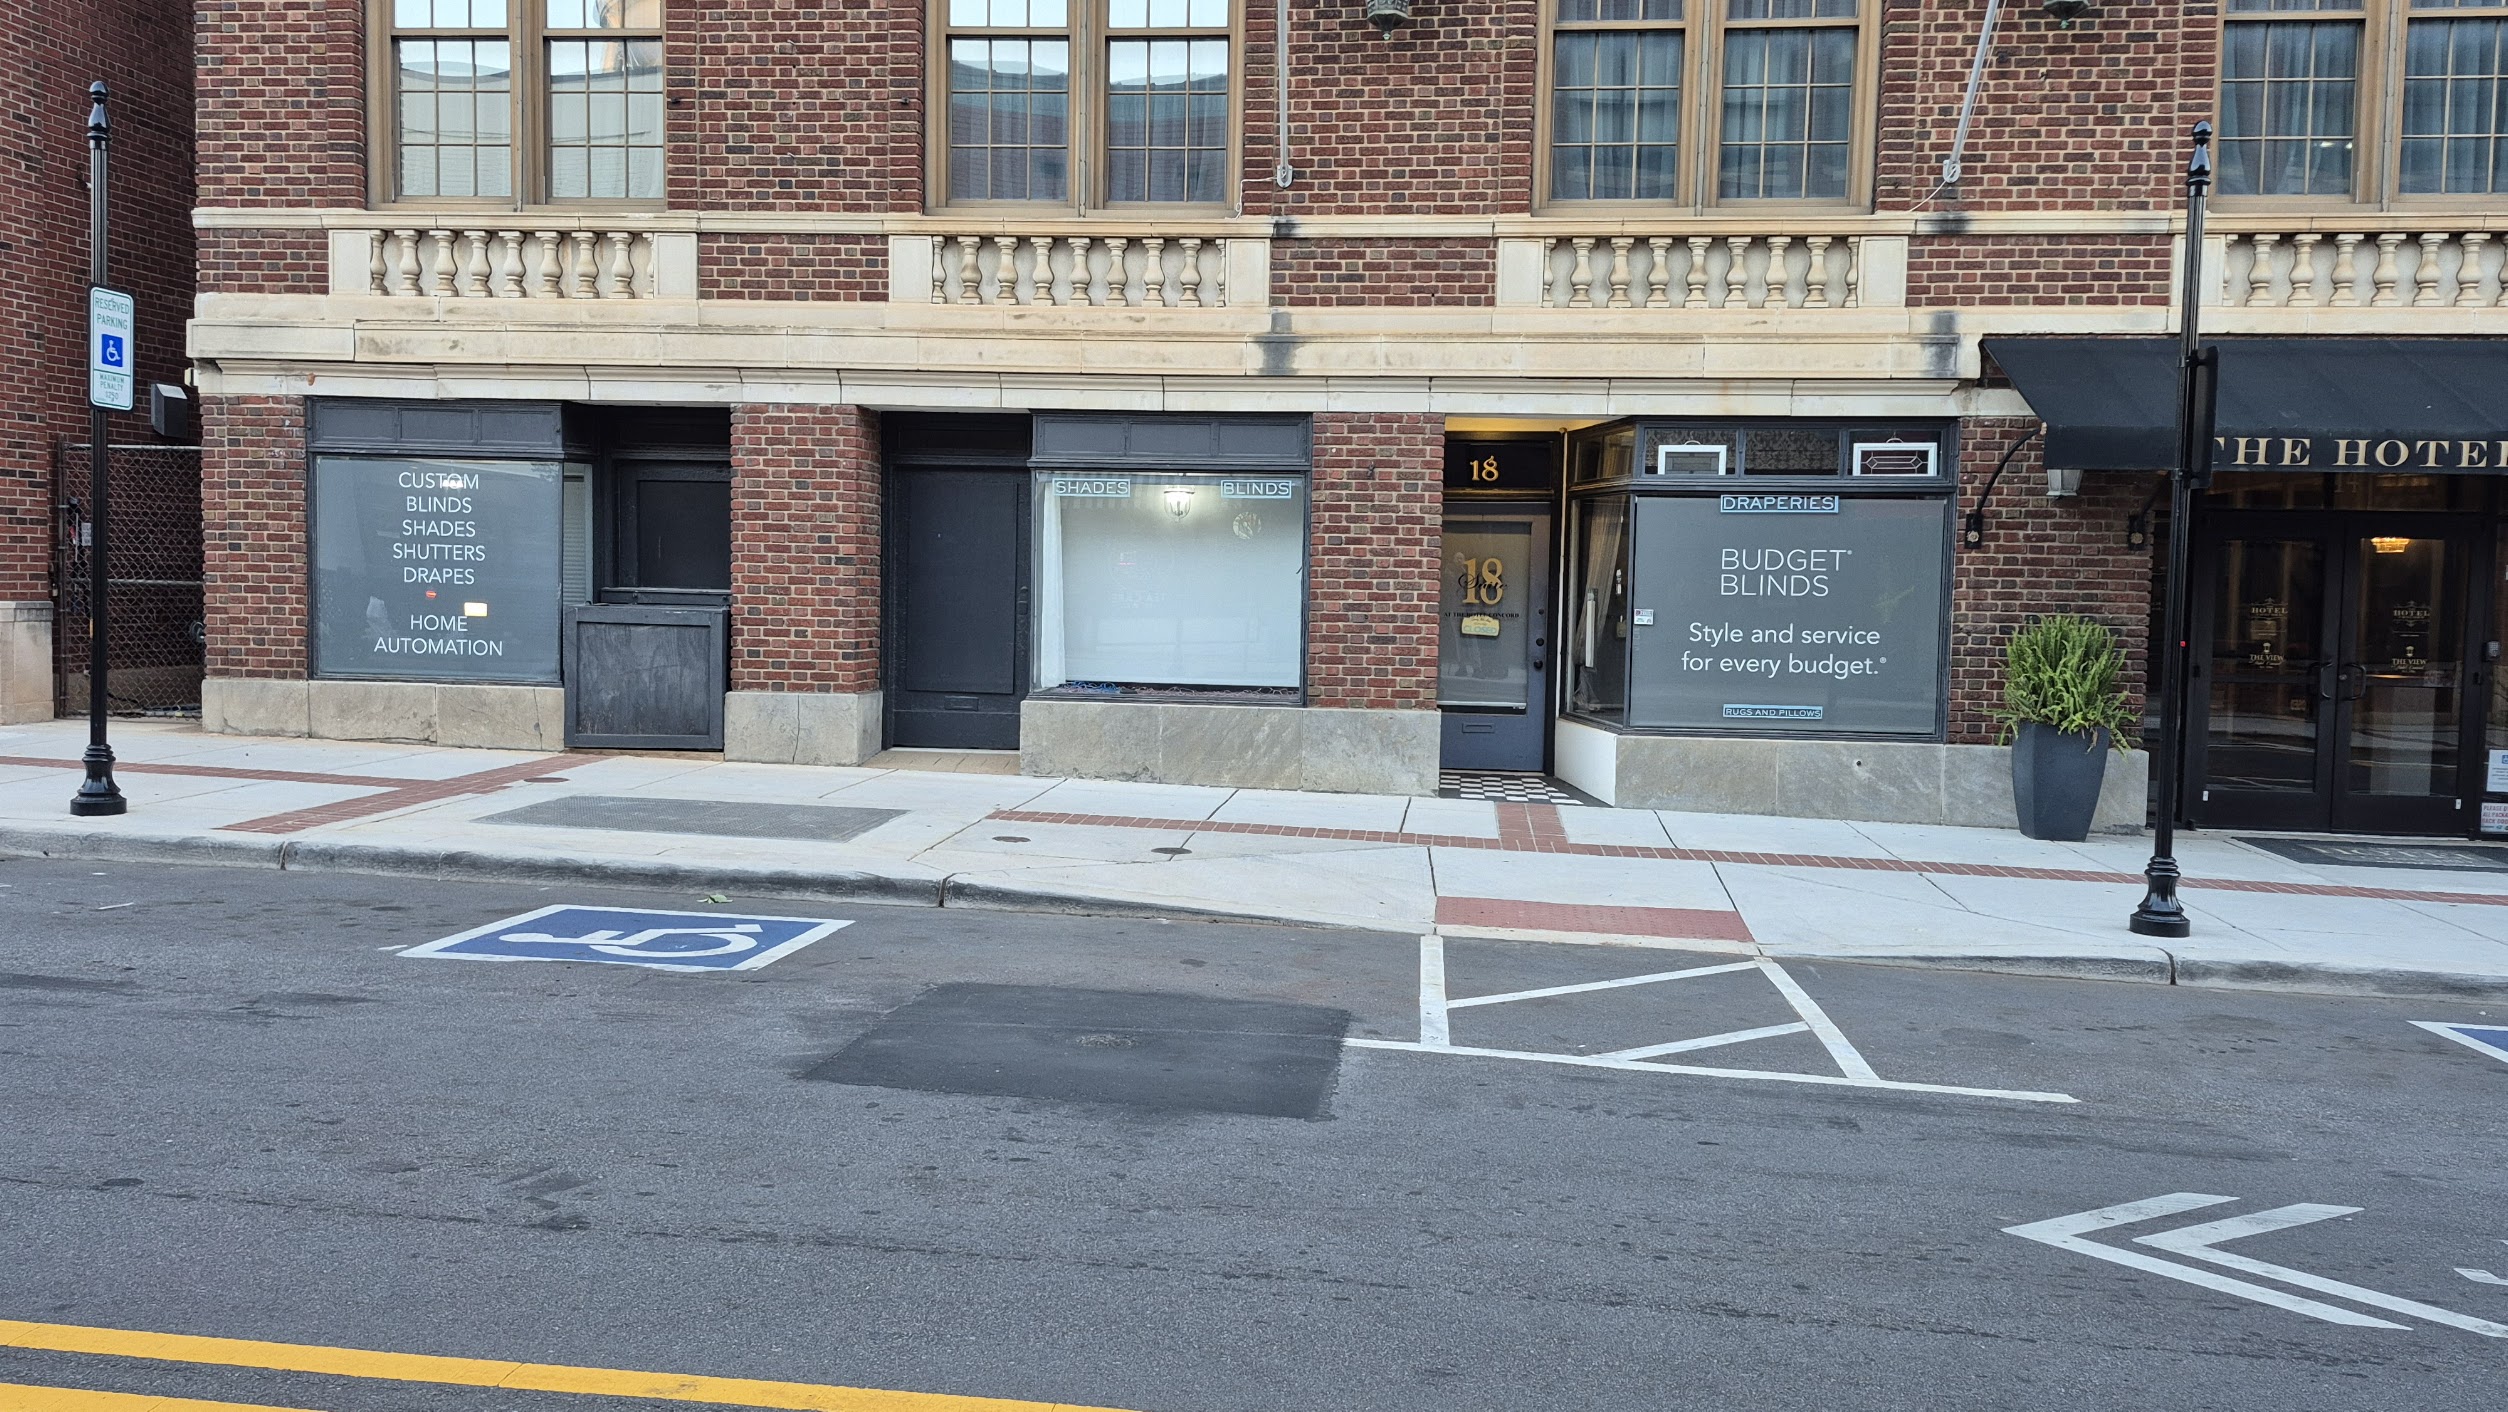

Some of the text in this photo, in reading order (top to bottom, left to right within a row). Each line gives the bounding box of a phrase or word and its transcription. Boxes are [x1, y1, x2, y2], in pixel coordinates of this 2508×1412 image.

[95, 297, 130, 315] RESERVED
[97, 314, 128, 330] PARKING
[100, 373, 124, 384] MAXIMUM
[100, 381, 123, 391] PENALTY
[1470, 455, 1499, 482] 18
[398, 471, 480, 490] CUSTOM
[1055, 481, 1129, 494] SHADES
[1223, 482, 1290, 495] BLINDS
[406, 496, 473, 514] BLINDS
[1722, 496, 1835, 510] DRAPERIES
[402, 519, 476, 538] SHADES
[393, 542, 486, 561] SHUTTERS
[403, 567, 475, 585] DRAPES
[1463, 557, 1503, 605] 18
[1721, 574, 1829, 597] BLINDS
[410, 614, 469, 632] HOME
[1464, 625, 1497, 634] CLOSED
[1688, 622, 1881, 648] Style and service
[373, 637, 503, 656] AUTOMATION
[1681, 651, 1713, 672] for
[1719, 657, 1781, 679] every
[1725, 708, 1821, 719] RUGS AND PILLOWS
